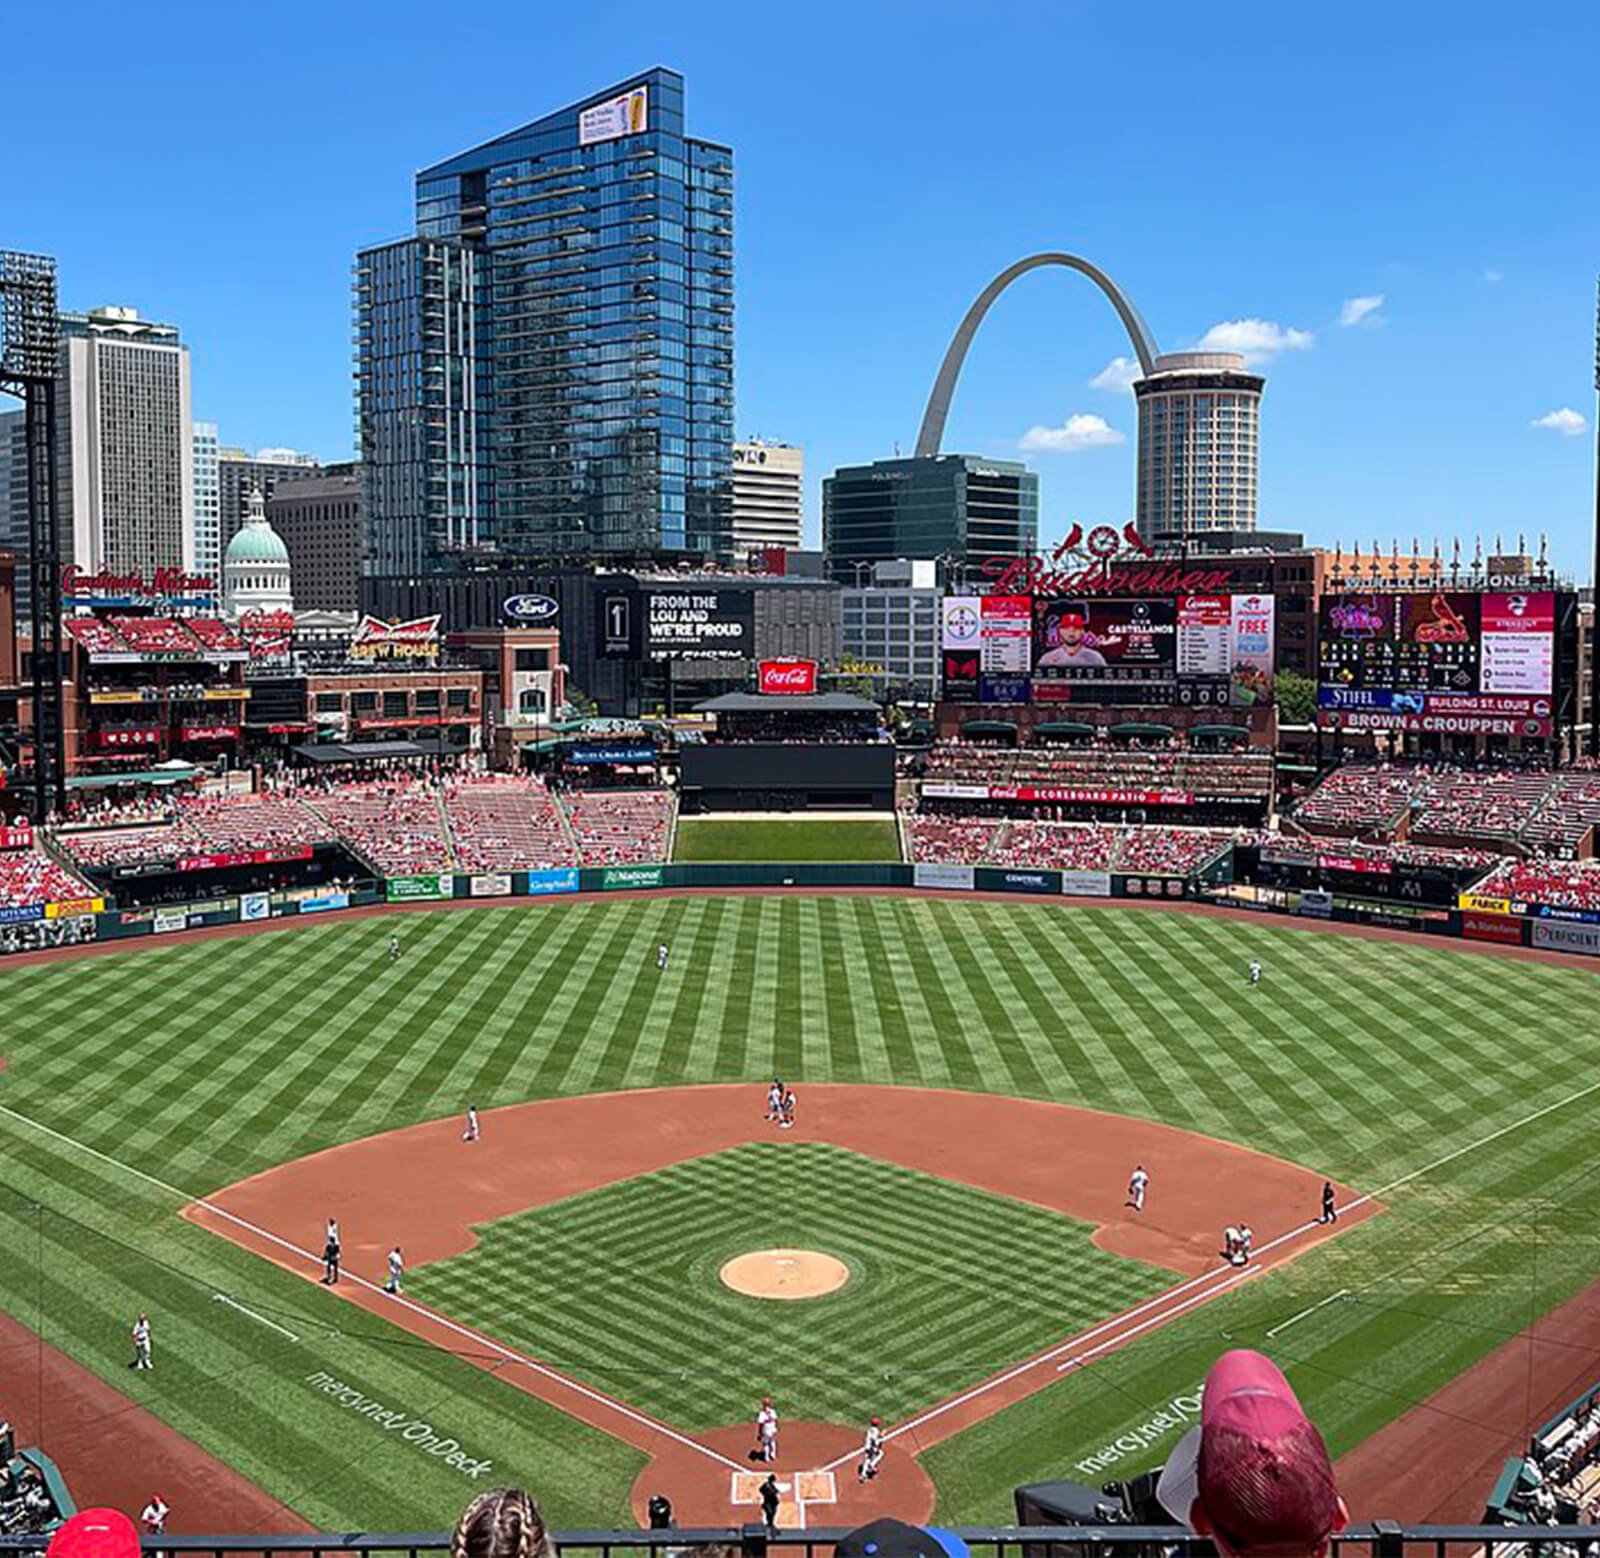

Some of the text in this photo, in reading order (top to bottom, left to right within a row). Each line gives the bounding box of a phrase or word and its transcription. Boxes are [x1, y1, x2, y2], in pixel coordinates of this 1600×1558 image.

[981, 555, 1230, 595] Budweiser
[1344, 574, 1530, 588] WORLD CHAMPIONS
[514, 598, 548, 614] Ford
[650, 596, 717, 609] FROM THE
[650, 610, 708, 622] LOU AND
[650, 624, 743, 636] WE'RE PROUD
[1107, 625, 1174, 634] CASTELLANOS
[1238, 620, 1268, 634] FREE
[393, 643, 439, 657] HOUSE
[765, 669, 808, 685] Coca-Cola
[1429, 697, 1530, 711] BUILDING ST. LOUIS
[1348, 714, 1407, 729] BROWN
[1423, 716, 1516, 734] CROUPPEN
[1034, 789, 1146, 803] SCOREBOARD PATIO
[305, 1371, 492, 1480] mercy.net/OnDeck
[1074, 1384, 1206, 1475] mercy.net/O
